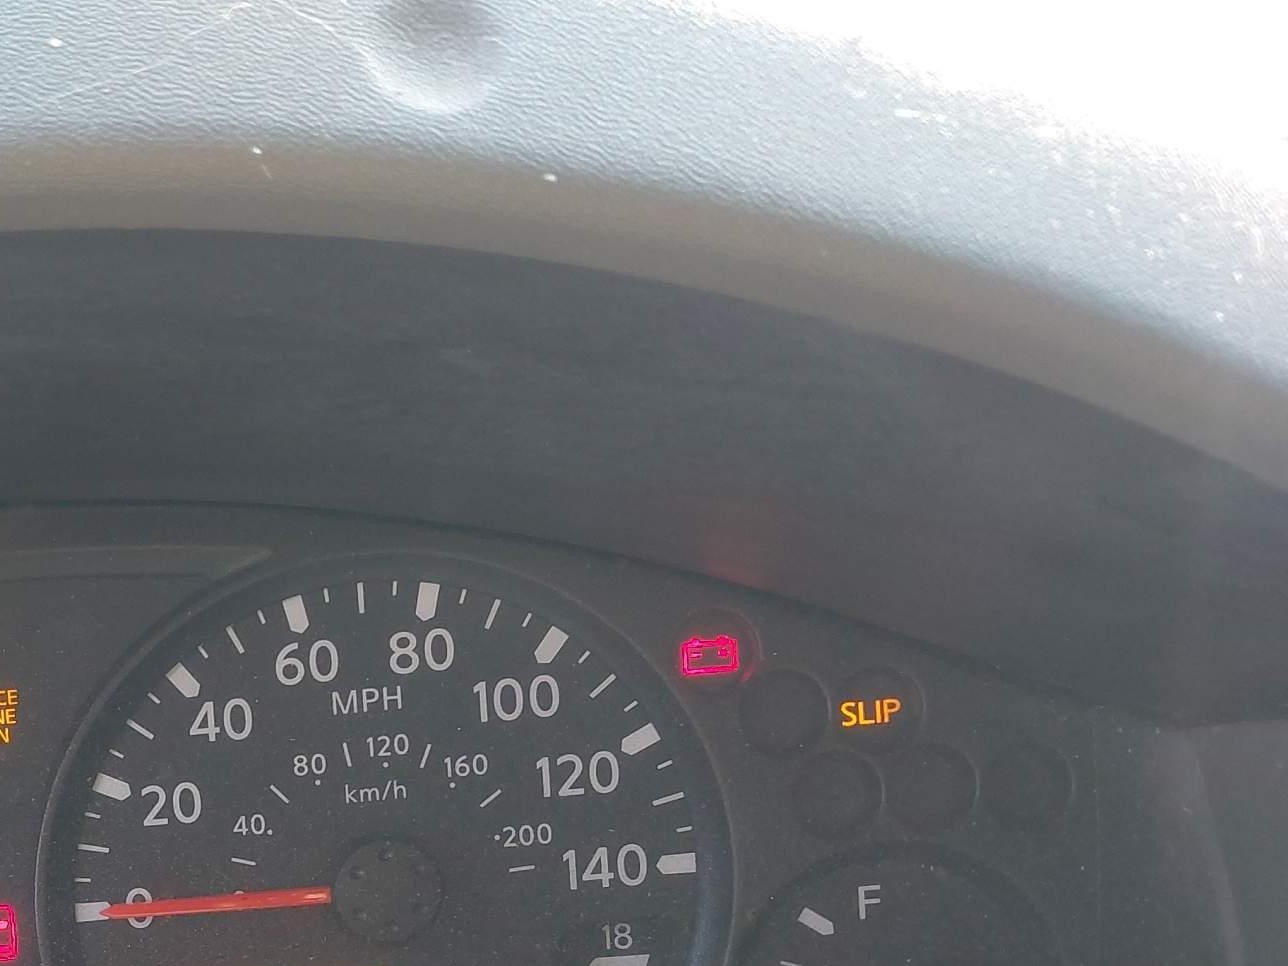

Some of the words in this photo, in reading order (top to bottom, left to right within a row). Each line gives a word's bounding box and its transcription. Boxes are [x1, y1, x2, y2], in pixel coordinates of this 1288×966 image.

[275, 639, 339, 687] 60
[388, 628, 456, 673] 80
[331, 686, 404, 717] MPH
[472, 674, 561, 723] 100
[840, 698, 901, 727] SLIP
[189, 697, 253, 744] 40
[366, 734, 410, 757] 120
[292, 753, 328, 777] 80
[443, 753, 489, 779] 160
[535, 750, 621, 800] 120
[142, 781, 203, 828] 20
[344, 779, 408, 806] km/h
[232, 814, 266, 837] 40
[502, 822, 553, 849] 200
[562, 846, 650, 892] 140
[857, 884, 882, 920] F
[601, 922, 633, 951] 18
